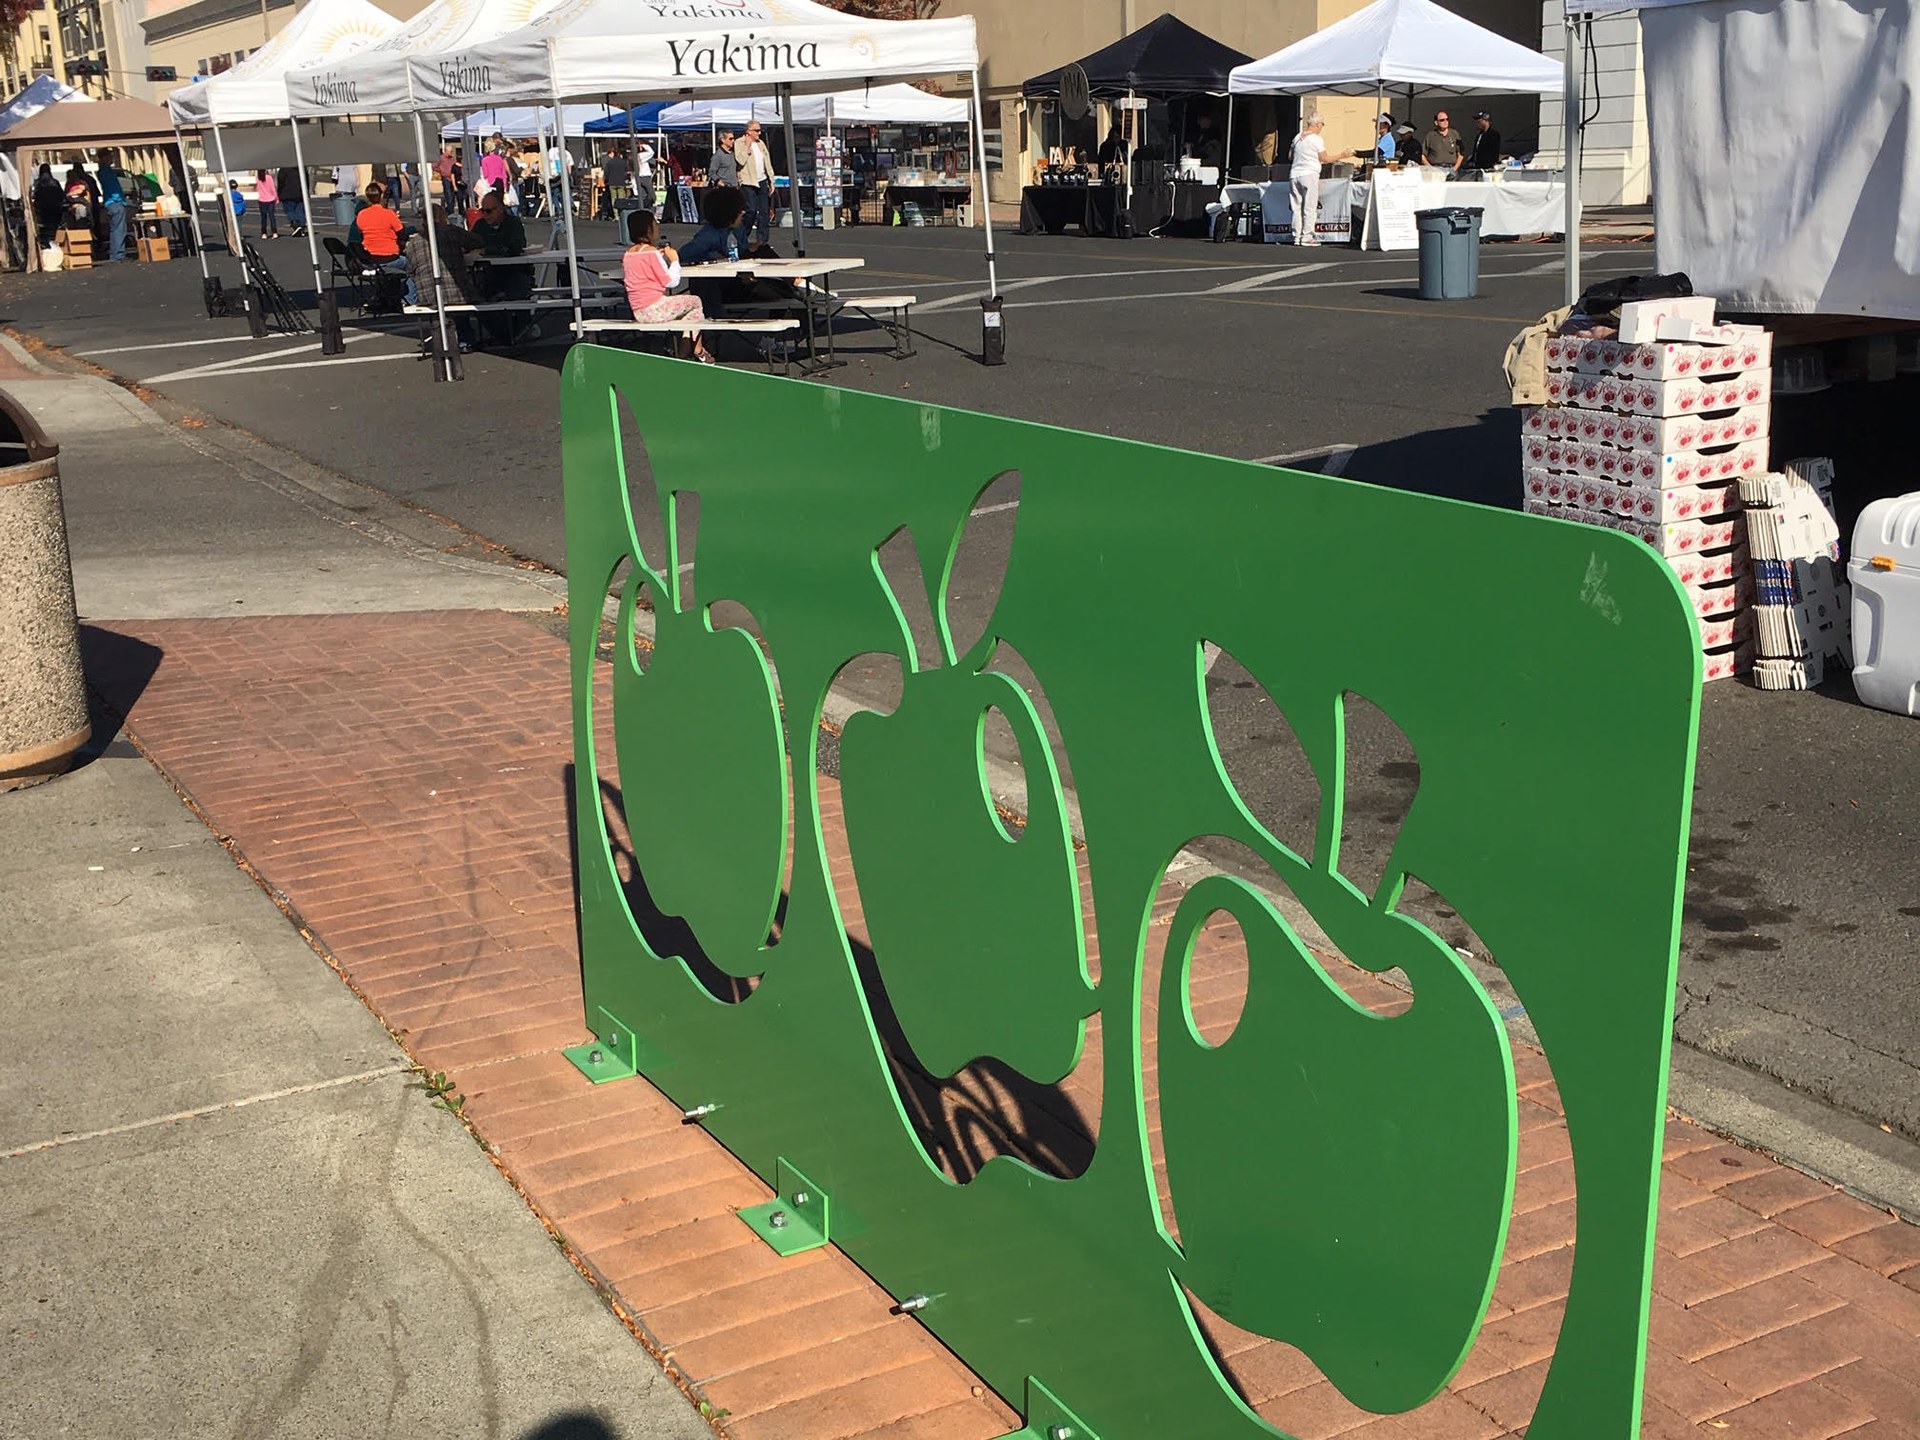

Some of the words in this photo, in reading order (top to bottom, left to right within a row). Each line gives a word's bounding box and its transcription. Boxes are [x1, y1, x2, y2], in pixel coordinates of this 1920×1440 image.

[648, 4, 765, 20] Yakima
[666, 33, 821, 77] Yakima
[312, 73, 359, 106] Yakima
[439, 56, 493, 97] Yakima
